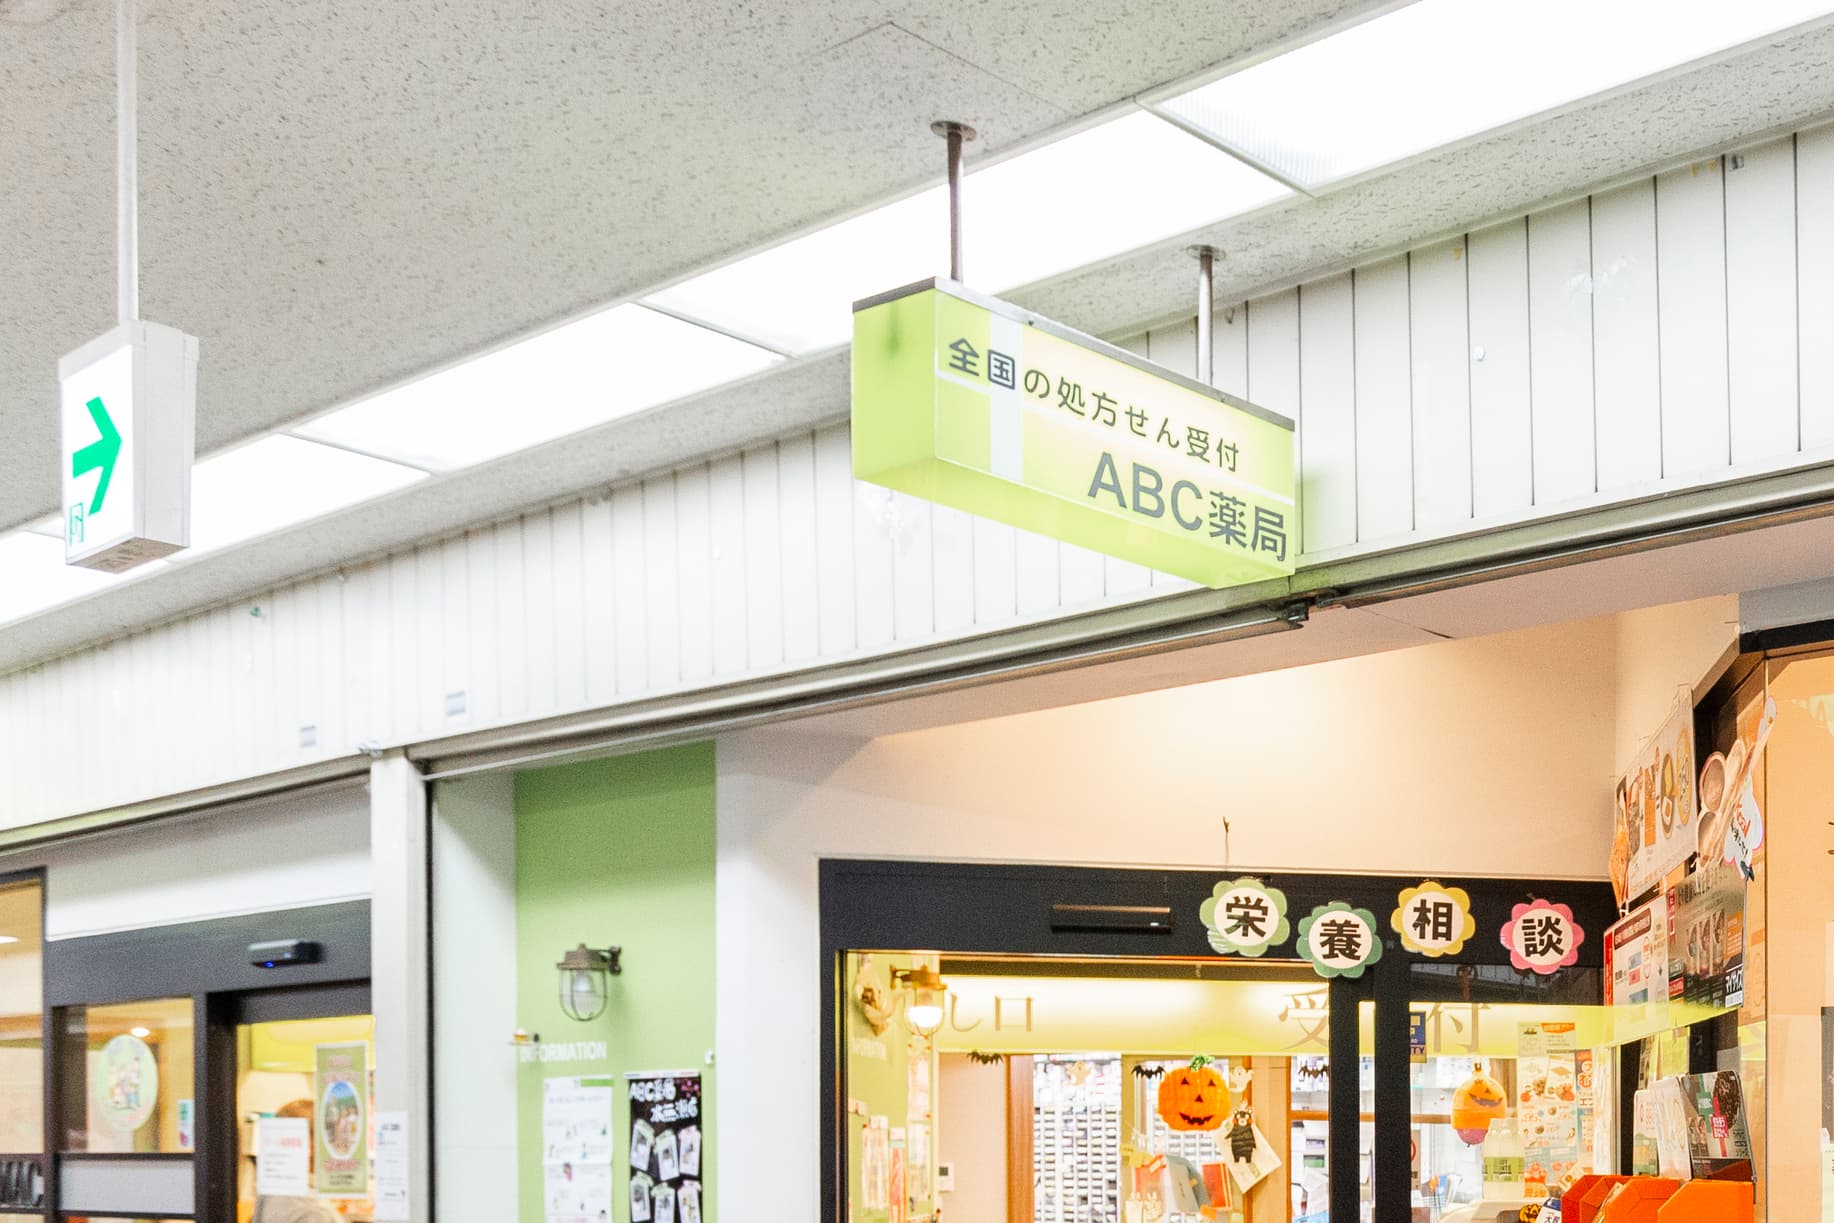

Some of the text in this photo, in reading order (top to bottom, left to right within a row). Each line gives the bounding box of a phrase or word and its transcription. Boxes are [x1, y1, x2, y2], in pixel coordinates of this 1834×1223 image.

[948, 338, 1240, 473] 全国の処方せん受付
[1087, 451, 1288, 562] ABC薬局
